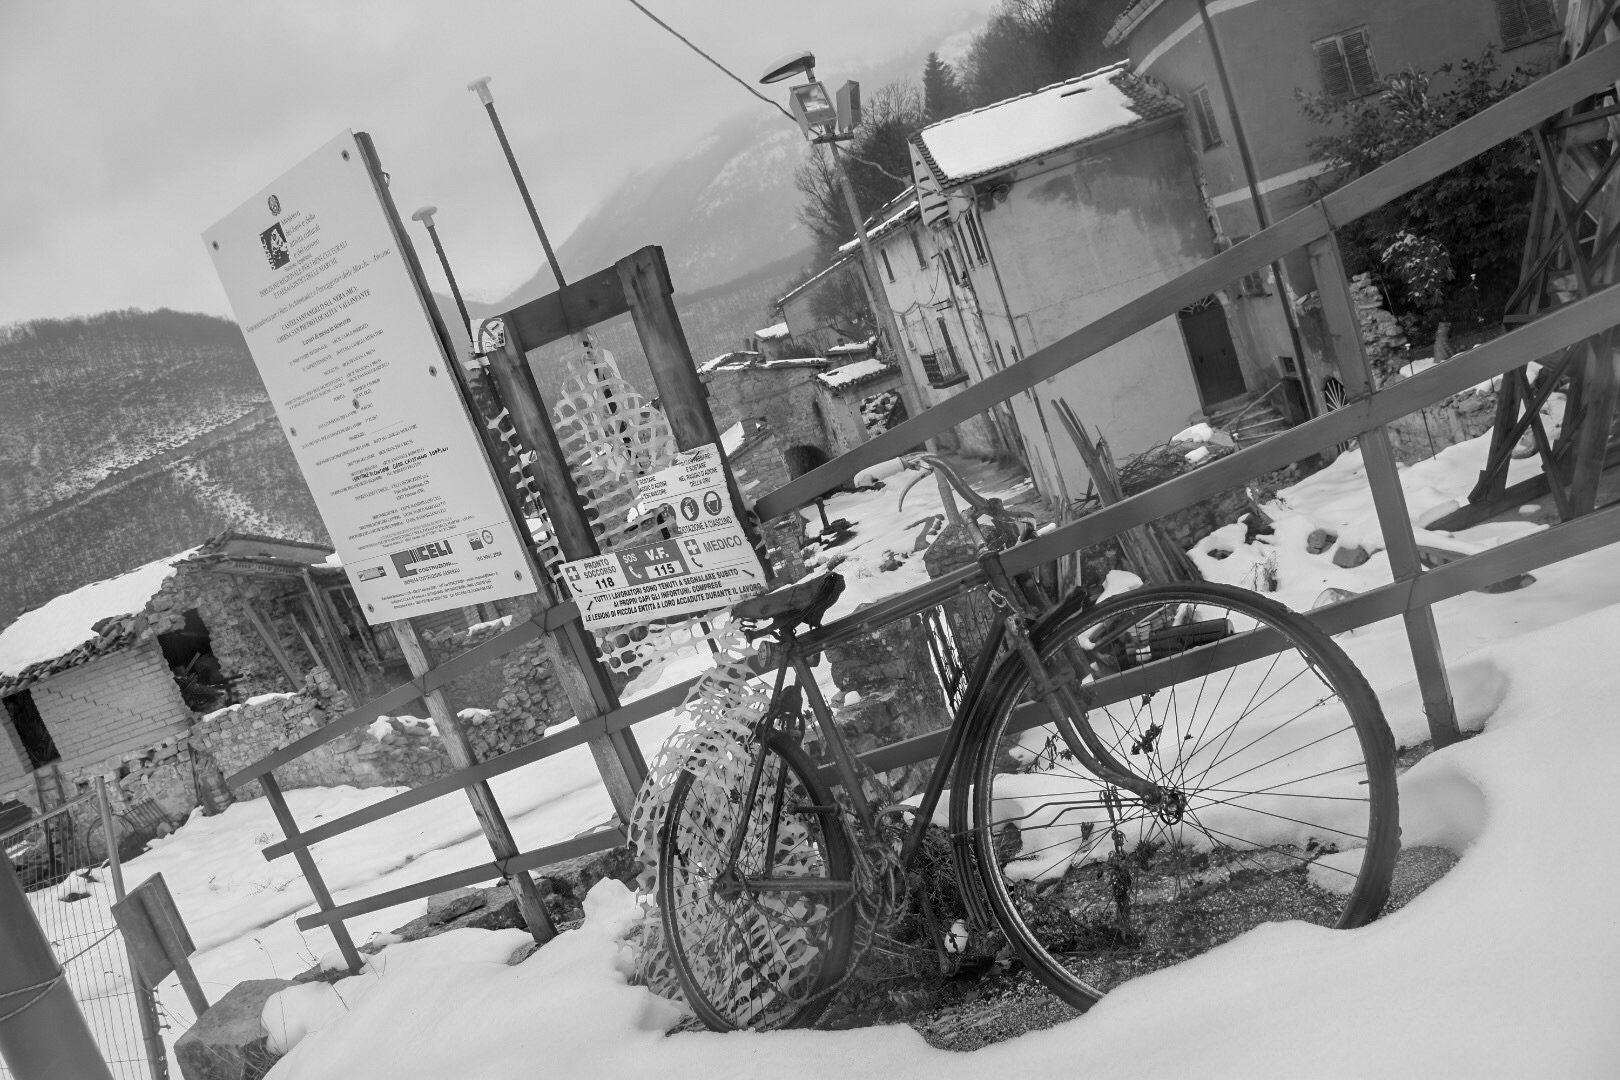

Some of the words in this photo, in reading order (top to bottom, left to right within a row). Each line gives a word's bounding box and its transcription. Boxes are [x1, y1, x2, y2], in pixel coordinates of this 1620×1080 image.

[417, 540, 453, 562] CELI
[703, 535, 742, 552] MEDICO
[584, 558, 609, 570] PRONTO
[622, 553, 637, 564] SOS
[644, 547, 669, 561] V.F.
[583, 566, 617, 579] SOCCORSO
[654, 563, 675, 576] 115
[593, 594, 609, 603] TUTTI
[611, 588, 642, 599] LAVORATORI
[642, 584, 657, 593] SONO
[657, 580, 678, 590] TENUTI
[683, 573, 717, 585] SEGNALARE
[716, 568, 738, 579] SUBITO
[595, 577, 615, 589] 118
[619, 597, 638, 606] PROPRI
[638, 595, 650, 603] CAPI
[651, 593, 661, 601] GLI
[692, 581, 722, 593] COMPRESE
[585, 614, 592, 622] LE
[592, 611, 610, 621] LESIONI
[616, 606, 637, 616] PICCOLA
[661, 599, 675, 608] LORO
[677, 593, 705, 605] ACCADUTE
[705, 588, 732, 600] DURANTE
[732, 587, 738, 595] IL
